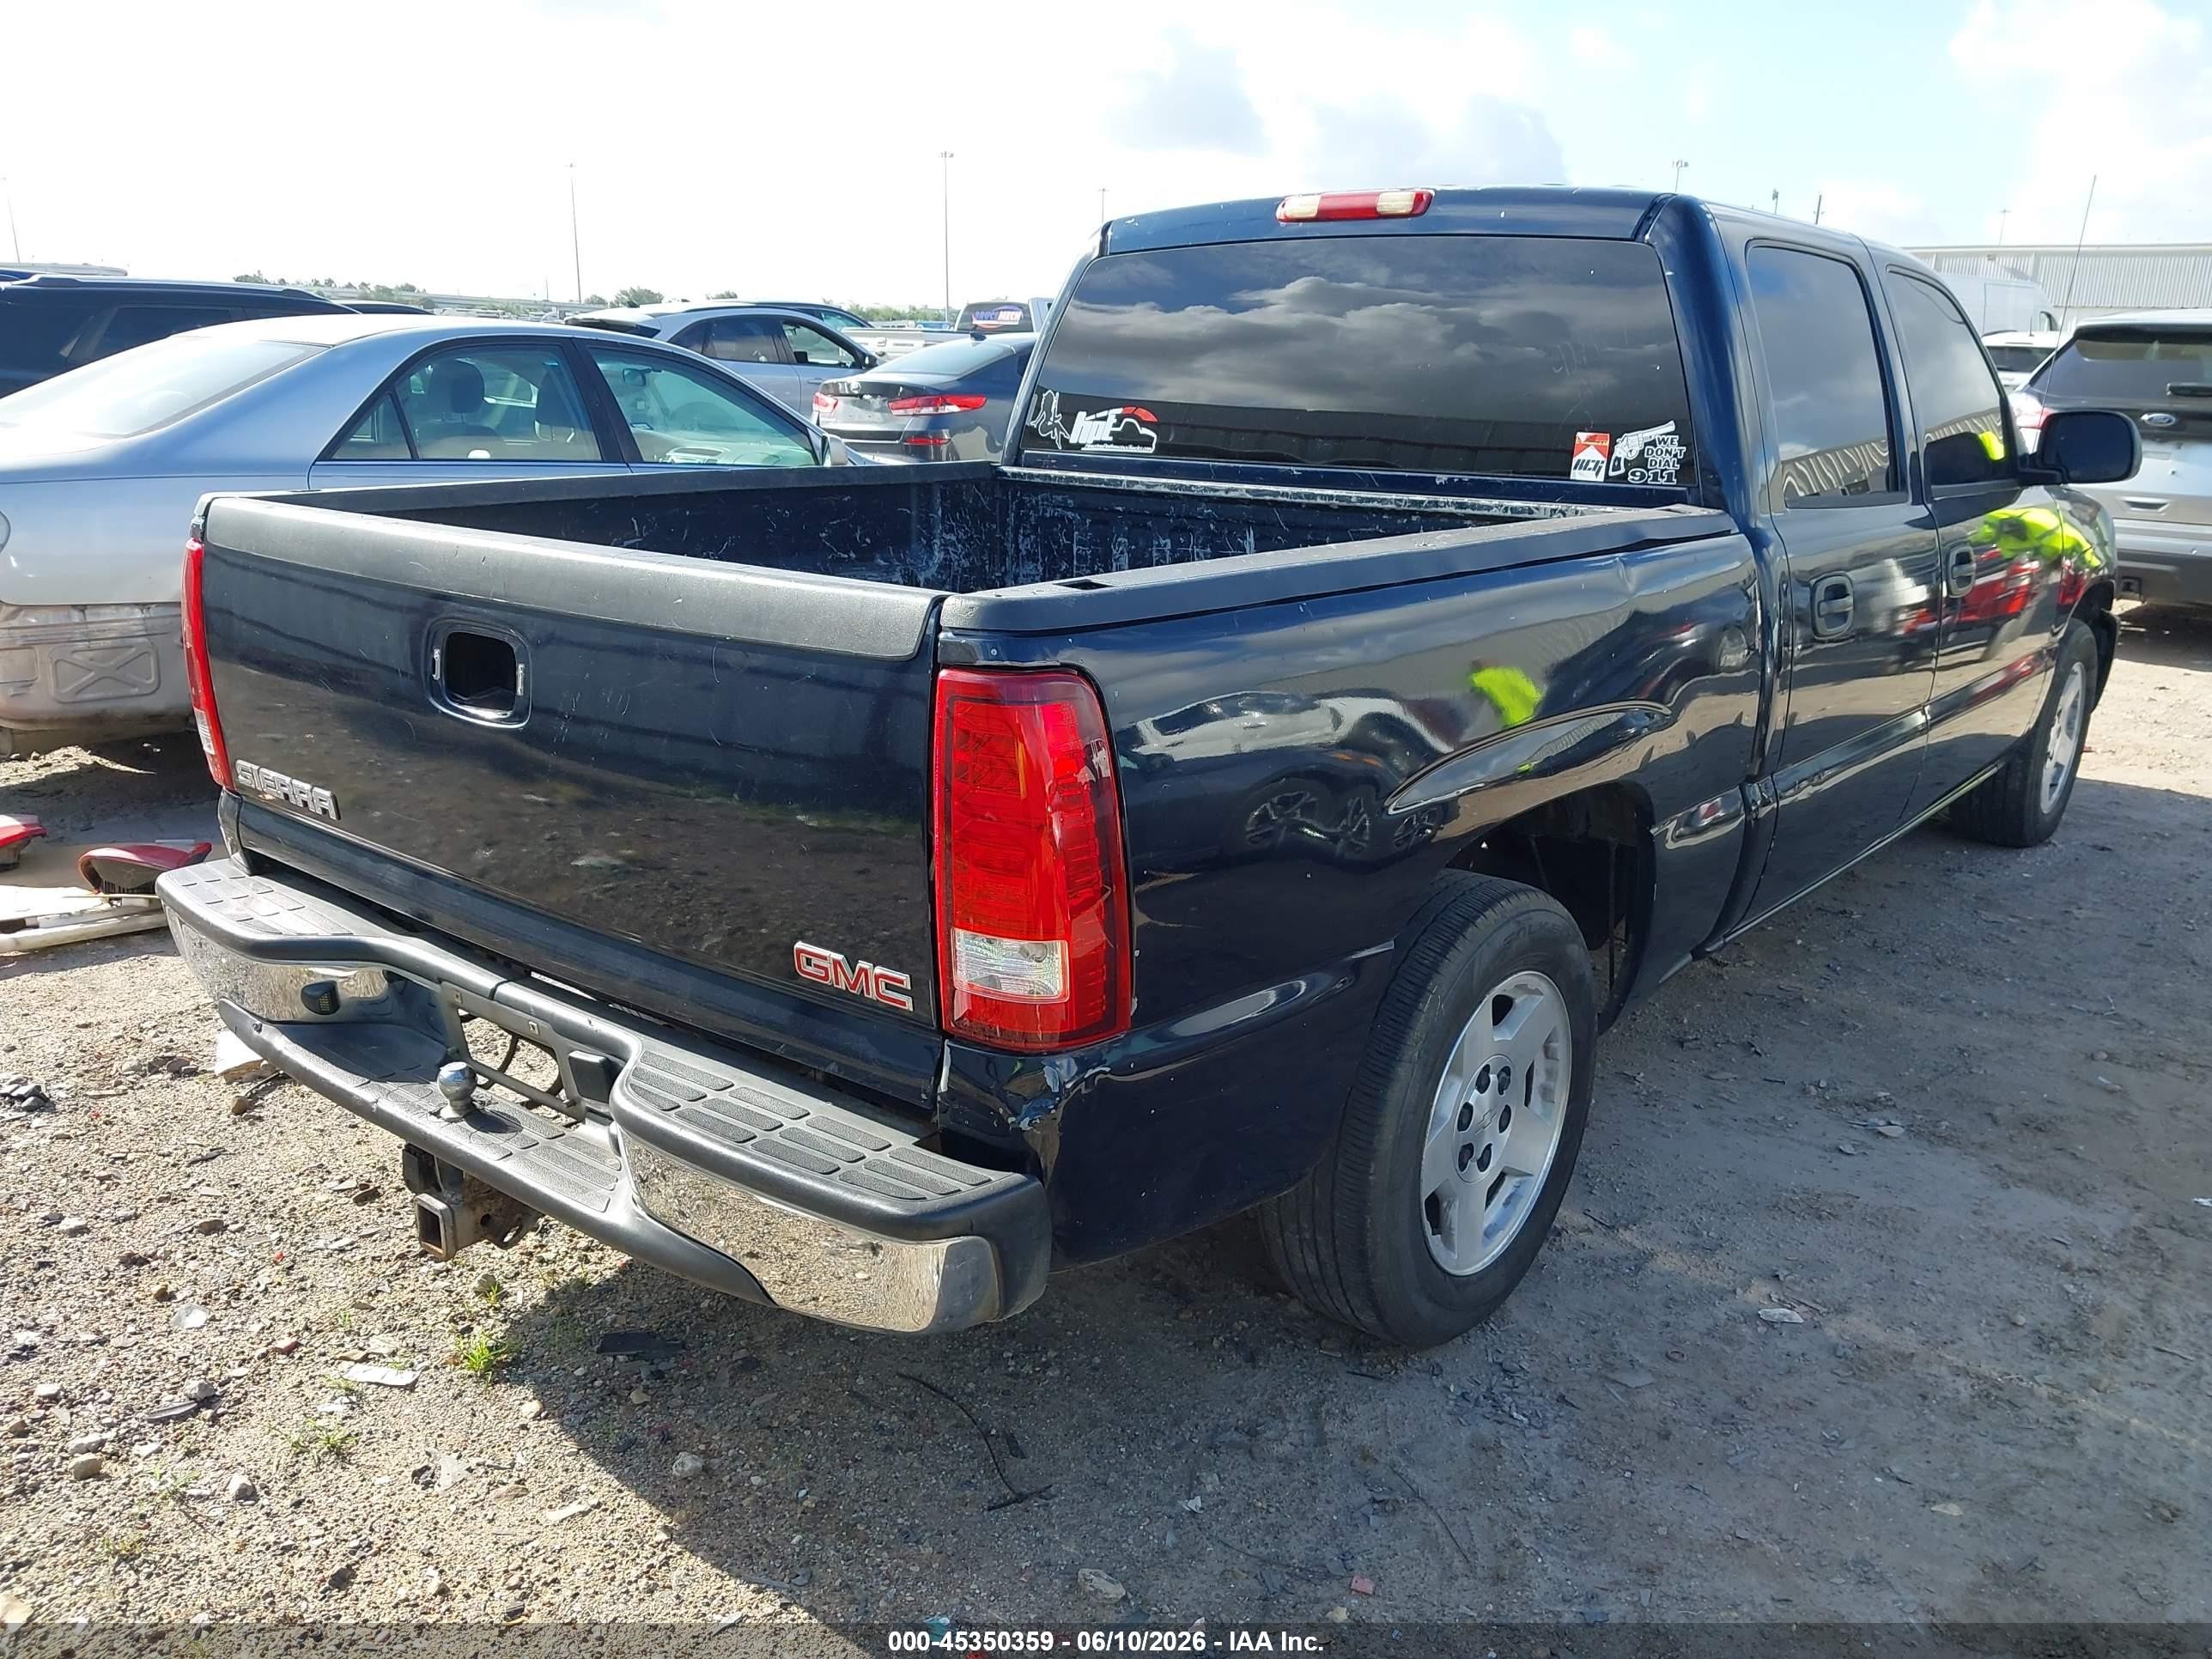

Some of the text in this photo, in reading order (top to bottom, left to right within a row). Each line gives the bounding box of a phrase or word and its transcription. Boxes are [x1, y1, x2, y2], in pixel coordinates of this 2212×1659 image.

[1656, 434, 1679, 447] WE
[1644, 446, 1686, 458] DON'T
[1648, 458, 1680, 469] DIAL
[1628, 468, 1676, 484] 911
[235, 759, 340, 820] SIERRA
[793, 941, 914, 1012] GMC
